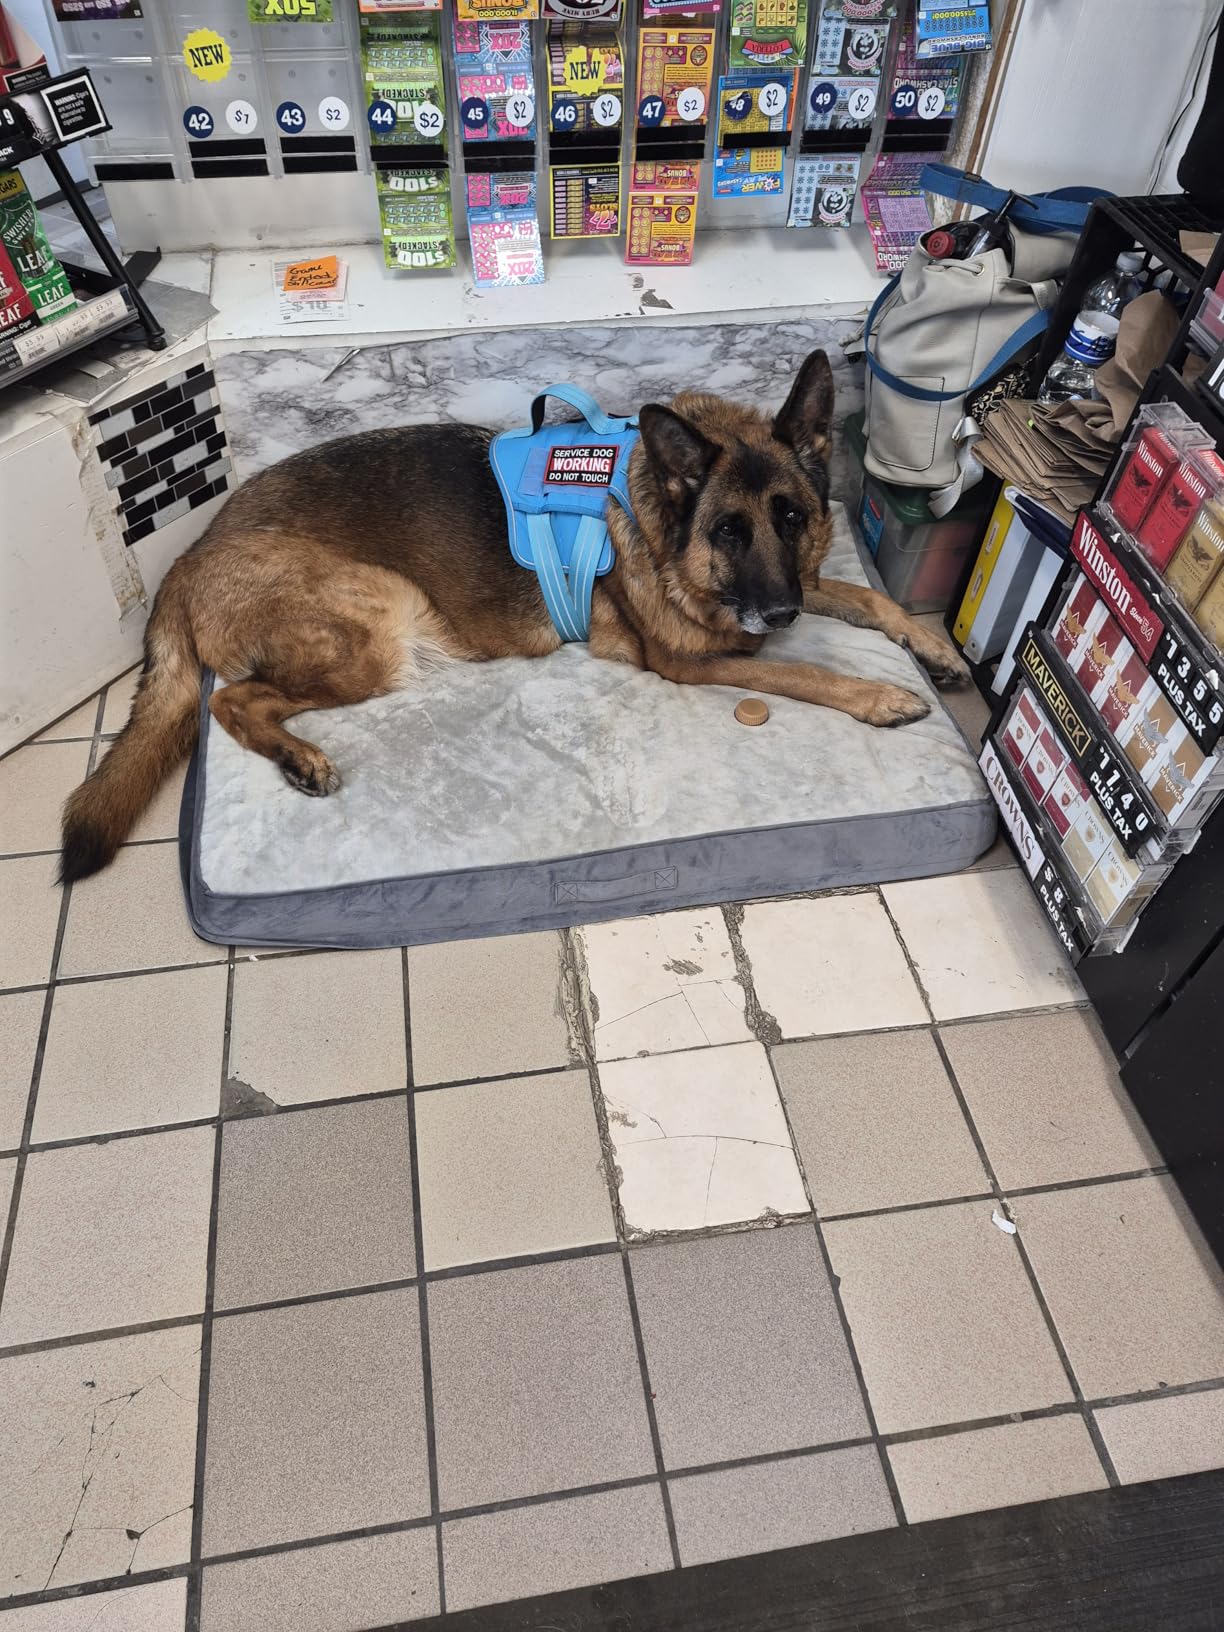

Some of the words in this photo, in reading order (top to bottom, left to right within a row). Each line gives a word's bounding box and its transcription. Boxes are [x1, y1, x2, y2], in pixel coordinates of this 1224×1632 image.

[490, 32, 522, 50] 20X
[931, 42, 962, 53] BLUE
[965, 39, 985, 50] BIG
[188, 44, 225, 68] NEW
[569, 60, 601, 81] NEW
[767, 86, 779, 107] $2
[816, 93, 831, 105] 49
[855, 95, 869, 112] $2
[895, 91, 914, 107] 50
[925, 94, 938, 112] $2
[467, 107, 484, 120] 45
[513, 100, 526, 119] $2
[555, 108, 576, 122] 46
[601, 100, 615, 118] $2
[642, 101, 663, 118] 47
[683, 100, 699, 112] $2
[189, 113, 212, 130] 42
[235, 109, 249, 125] $1
[281, 109, 303, 126] 43
[326, 109, 342, 122] $2
[371, 108, 394, 125] 44
[420, 112, 440, 129] $2
[667, 169, 687, 178] BONUS
[391, 177, 438, 191] $100
[500, 191, 528, 204] 20X
[589, 203, 619, 212] SLOTS
[3, 209, 33, 242] SWISHER
[589, 210, 618, 230] 777
[12, 219, 35, 244] SWEETS
[661, 244, 680, 252] BONUS
[878, 253, 909, 261] SHWORD
[17, 246, 49, 273] LEAF
[398, 251, 445, 267] $100
[508, 261, 535, 275] 20X
[290, 264, 324, 275] Game
[37, 283, 65, 306] LEAF
[553, 449, 590, 458] SERVICE
[593, 449, 614, 458] DOG
[1137, 439, 1164, 478] Winston
[552, 458, 611, 473] WORKING
[549, 473, 562, 481] DO
[562, 473, 578, 482] NOT
[581, 473, 609, 484] TOUCH
[1178, 460, 1207, 498] Winston
[1197, 511, 1224, 553] Winston
[1078, 519, 1132, 616] Winston
[1130, 607, 1144, 625] Since
[1060, 619, 1078, 649] MAVERICK
[1085, 649, 1105, 680] MAVERICK
[1027, 648, 1089, 748] MAVERICK
[1109, 686, 1130, 719] MAVERICK
[1158, 663, 1185, 706] PLUS
[1184, 703, 1206, 737] TAX
[1134, 724, 1156, 758] MAVERICK
[1161, 766, 1184, 802] MAVERICK
[986, 756, 1035, 861] CROWNS
[1089, 770, 1114, 812] PLUS
[1111, 806, 1133, 841] TAX
[1107, 850, 1128, 887] CROWNS
[1039, 885, 1060, 923] PLUS
[1059, 920, 1074, 952] TAX
